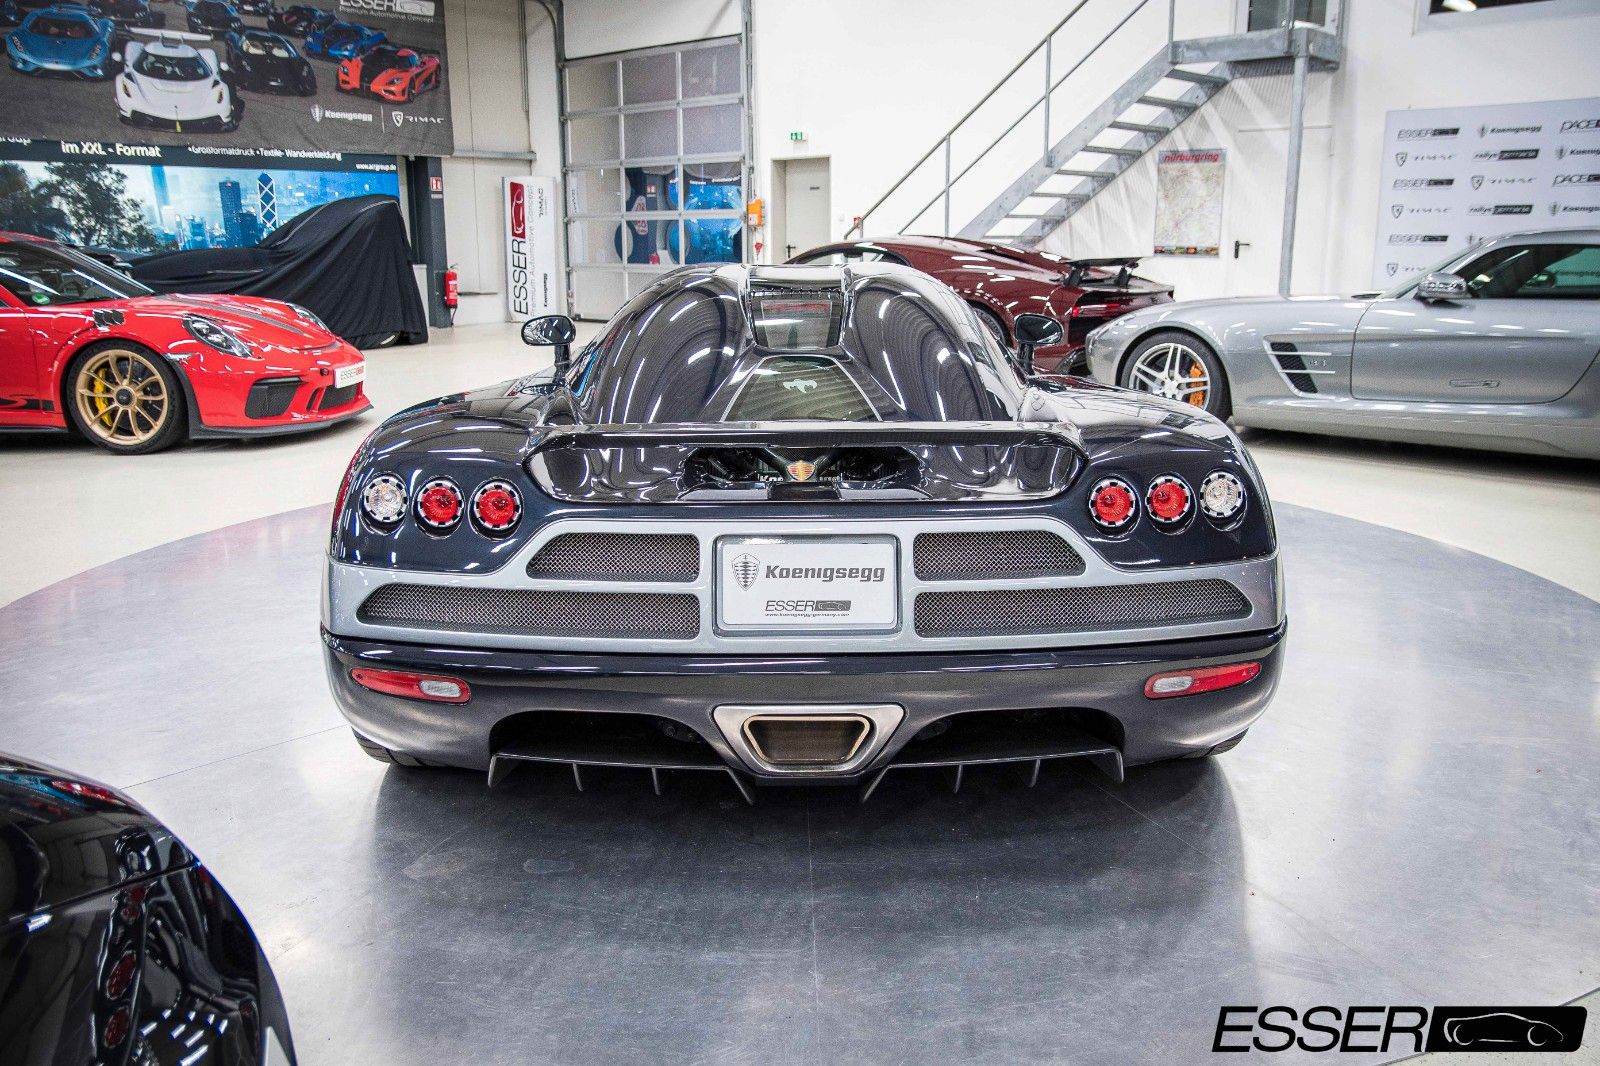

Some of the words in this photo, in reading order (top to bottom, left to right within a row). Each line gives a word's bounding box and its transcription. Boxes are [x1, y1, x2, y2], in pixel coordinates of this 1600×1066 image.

[369, 10, 406, 19] Automotive
[324, 109, 373, 122] Koenigsegg
[405, 115, 444, 123] RIMAC
[81, 141, 107, 155] XXL
[115, 142, 162, 157] Format
[511, 238, 528, 315] ESSER
[765, 565, 886, 582] Koenigsegg
[765, 600, 815, 611] ESSER
